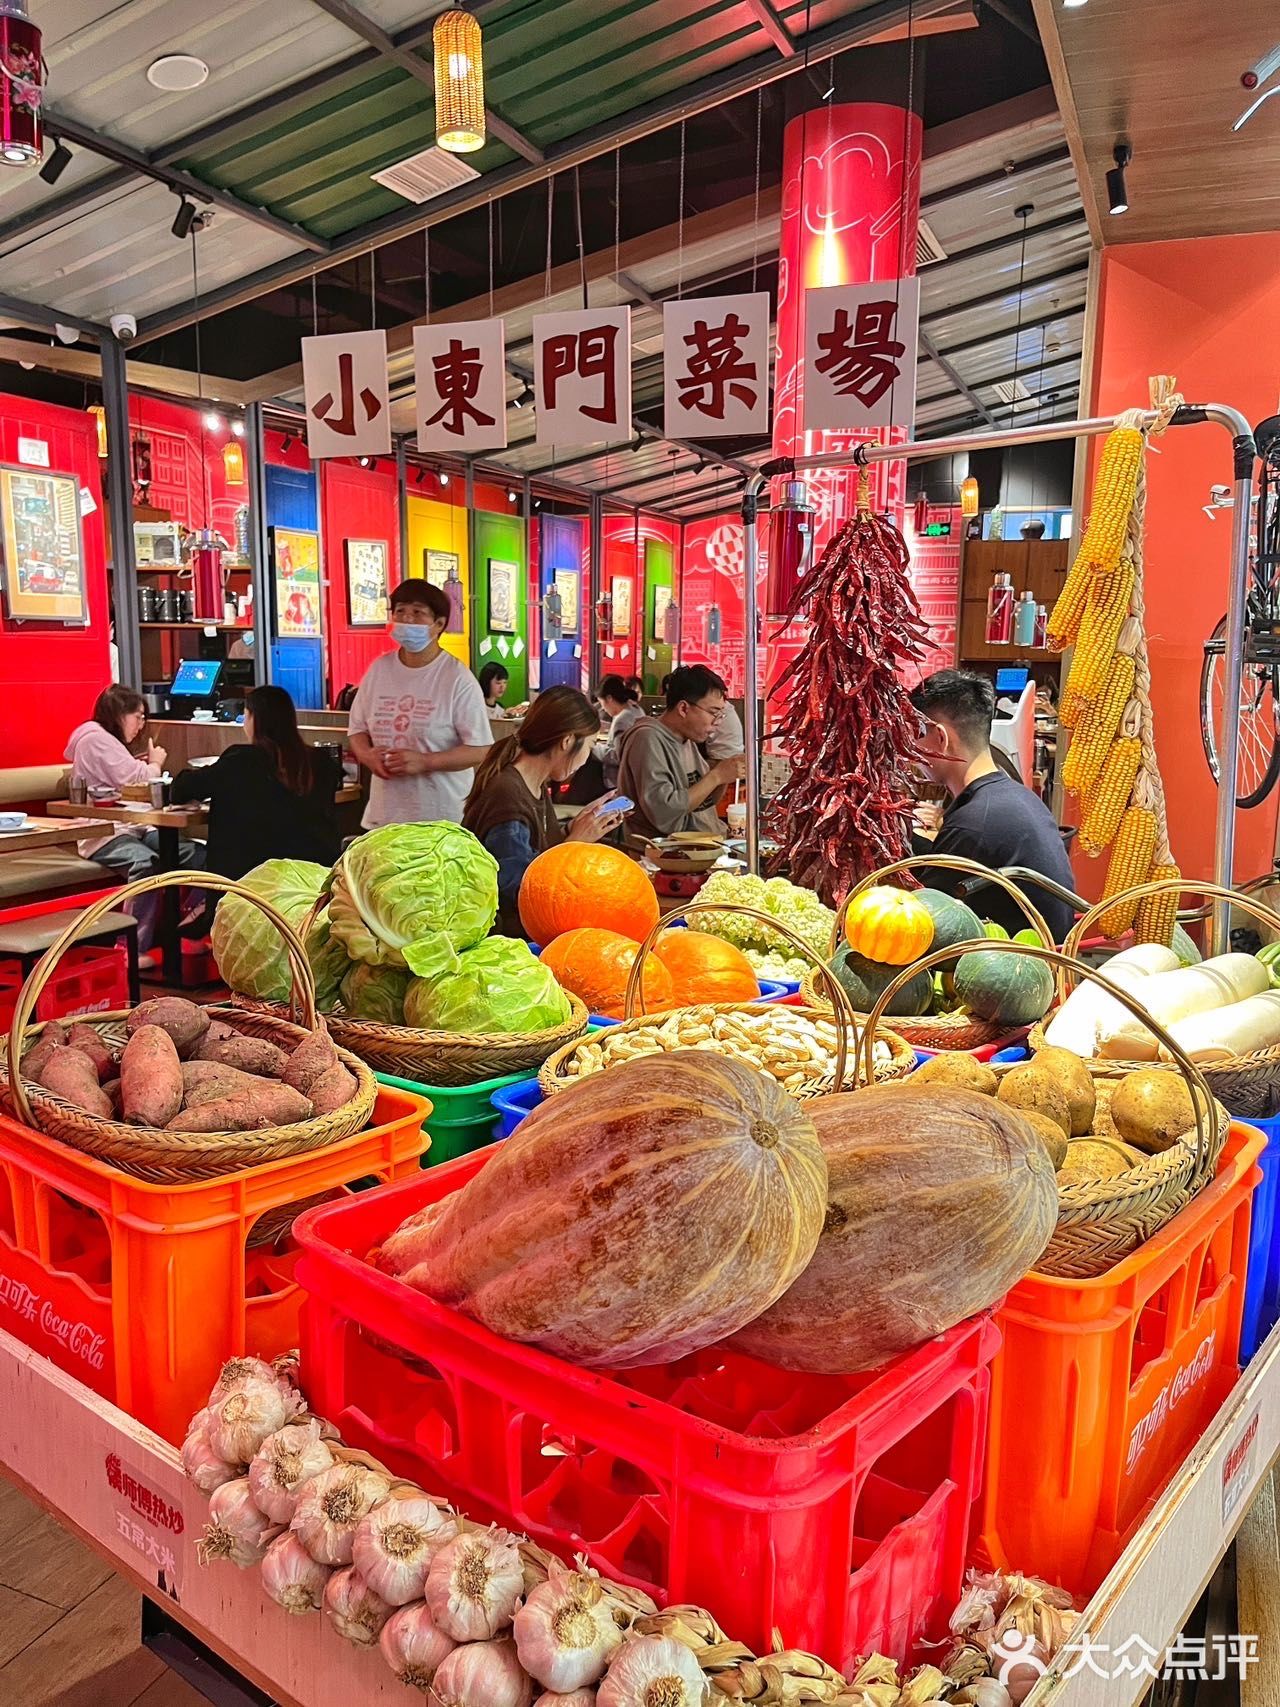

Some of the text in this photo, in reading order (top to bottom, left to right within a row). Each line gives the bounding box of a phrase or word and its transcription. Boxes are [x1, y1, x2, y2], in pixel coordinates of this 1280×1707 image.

[311, 300, 906, 436] 小東門菜場
[40, 1301, 106, 1370] Coca-Cola
[1126, 1329, 1216, 1476] 可口可乐 Coca-Cola
[116, 1511, 176, 1574] 五常大米
